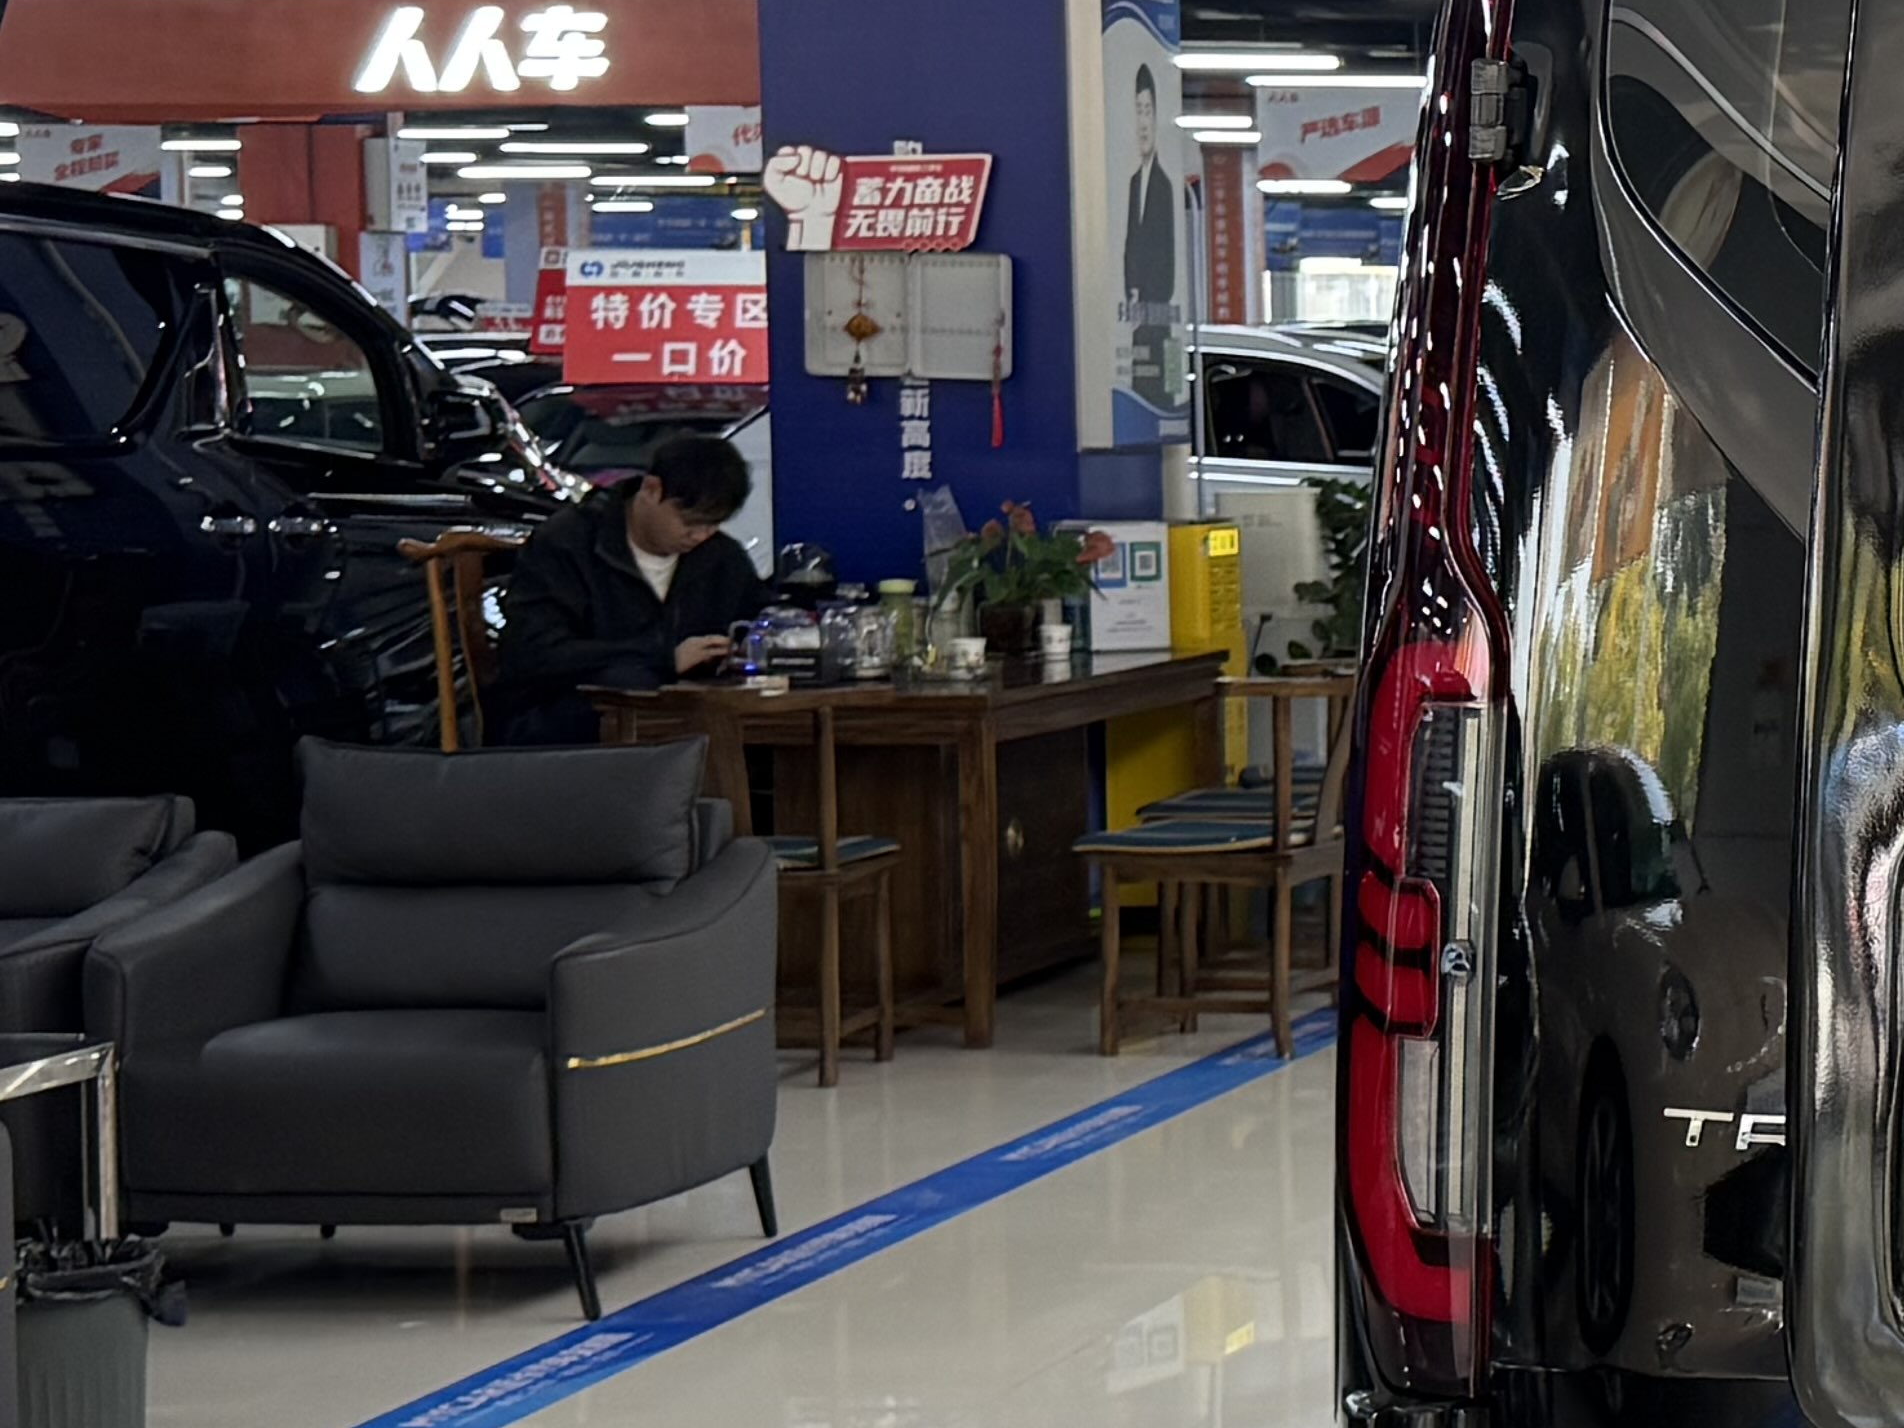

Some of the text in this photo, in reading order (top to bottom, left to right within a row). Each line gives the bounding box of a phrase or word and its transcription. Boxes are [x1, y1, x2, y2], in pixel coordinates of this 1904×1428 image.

[354, 5, 610, 92] 人人车
[853, 175, 975, 207] 蓄力奋战
[590, 292, 768, 330] 特价专区
[611, 338, 748, 377] 一口价
[900, 377, 932, 479] 新高度
